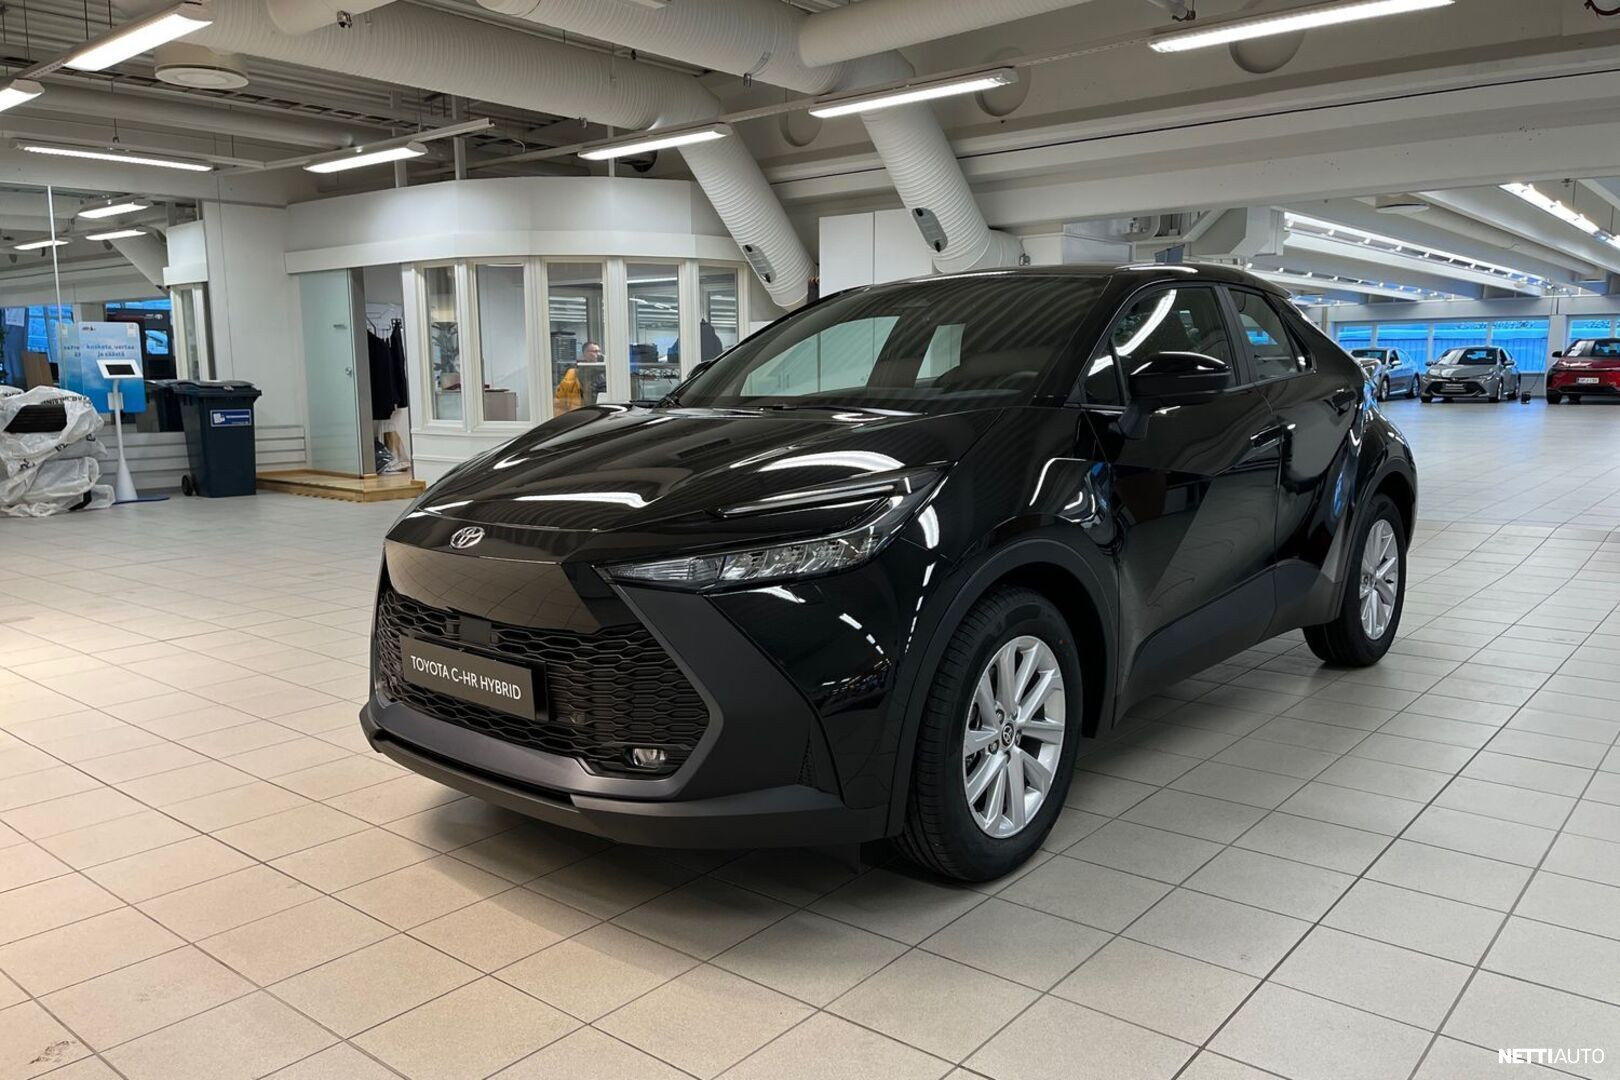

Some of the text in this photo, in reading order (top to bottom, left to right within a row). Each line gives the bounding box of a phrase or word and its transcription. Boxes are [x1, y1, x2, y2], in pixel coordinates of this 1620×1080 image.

[410, 655, 521, 700] TOYOTA C-HR HYBRID
